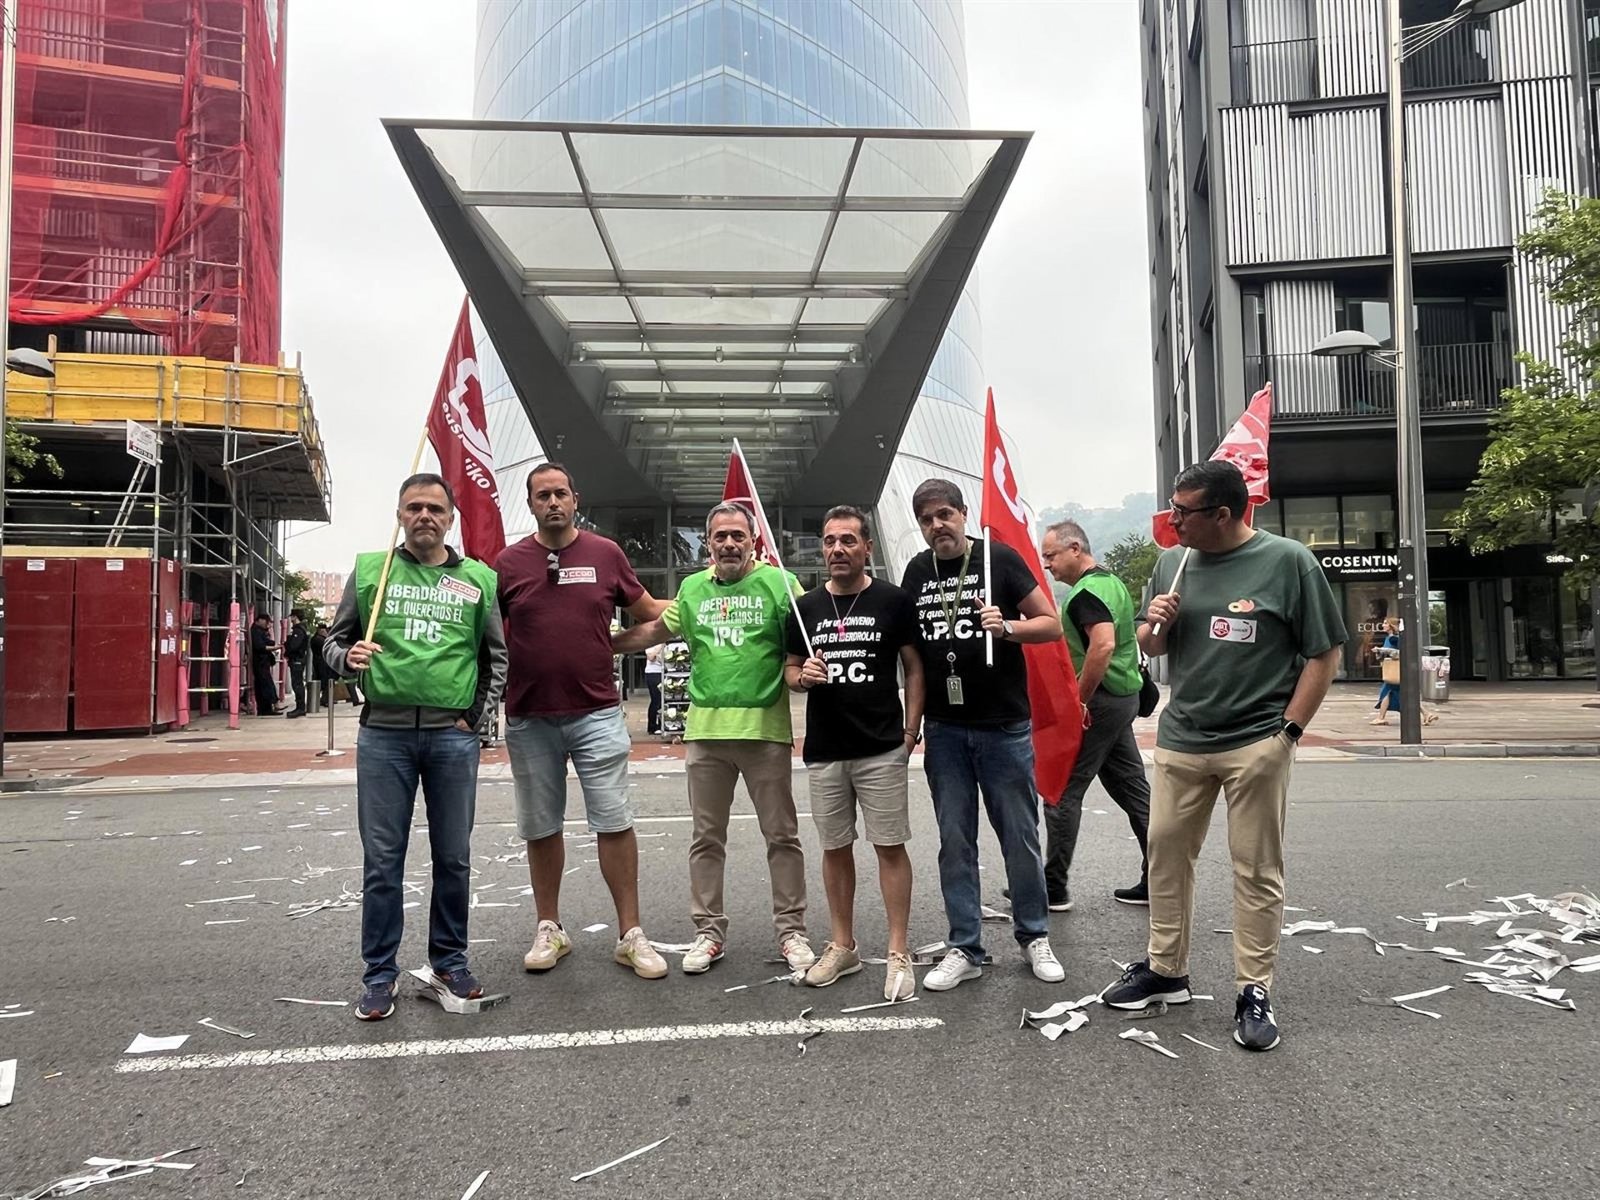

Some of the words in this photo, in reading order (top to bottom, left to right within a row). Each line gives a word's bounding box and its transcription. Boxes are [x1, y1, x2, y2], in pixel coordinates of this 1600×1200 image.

[1321, 554, 1400, 568] COSENTIN
[946, 574, 979, 587] CONENIO
[387, 584, 464, 606] IBERDROLA
[700, 595, 763, 613] IBERDROLA
[404, 601, 452, 620] QUEREMOS
[453, 609, 463, 623] EL
[754, 611, 764, 625] EL
[822, 618, 833, 628] Por
[842, 615, 876, 627] CONVENIO
[403, 617, 442, 643] IPC
[712, 625, 745, 647] IPC
[828, 632, 838, 643] EN
[822, 649, 867, 662] queremos
